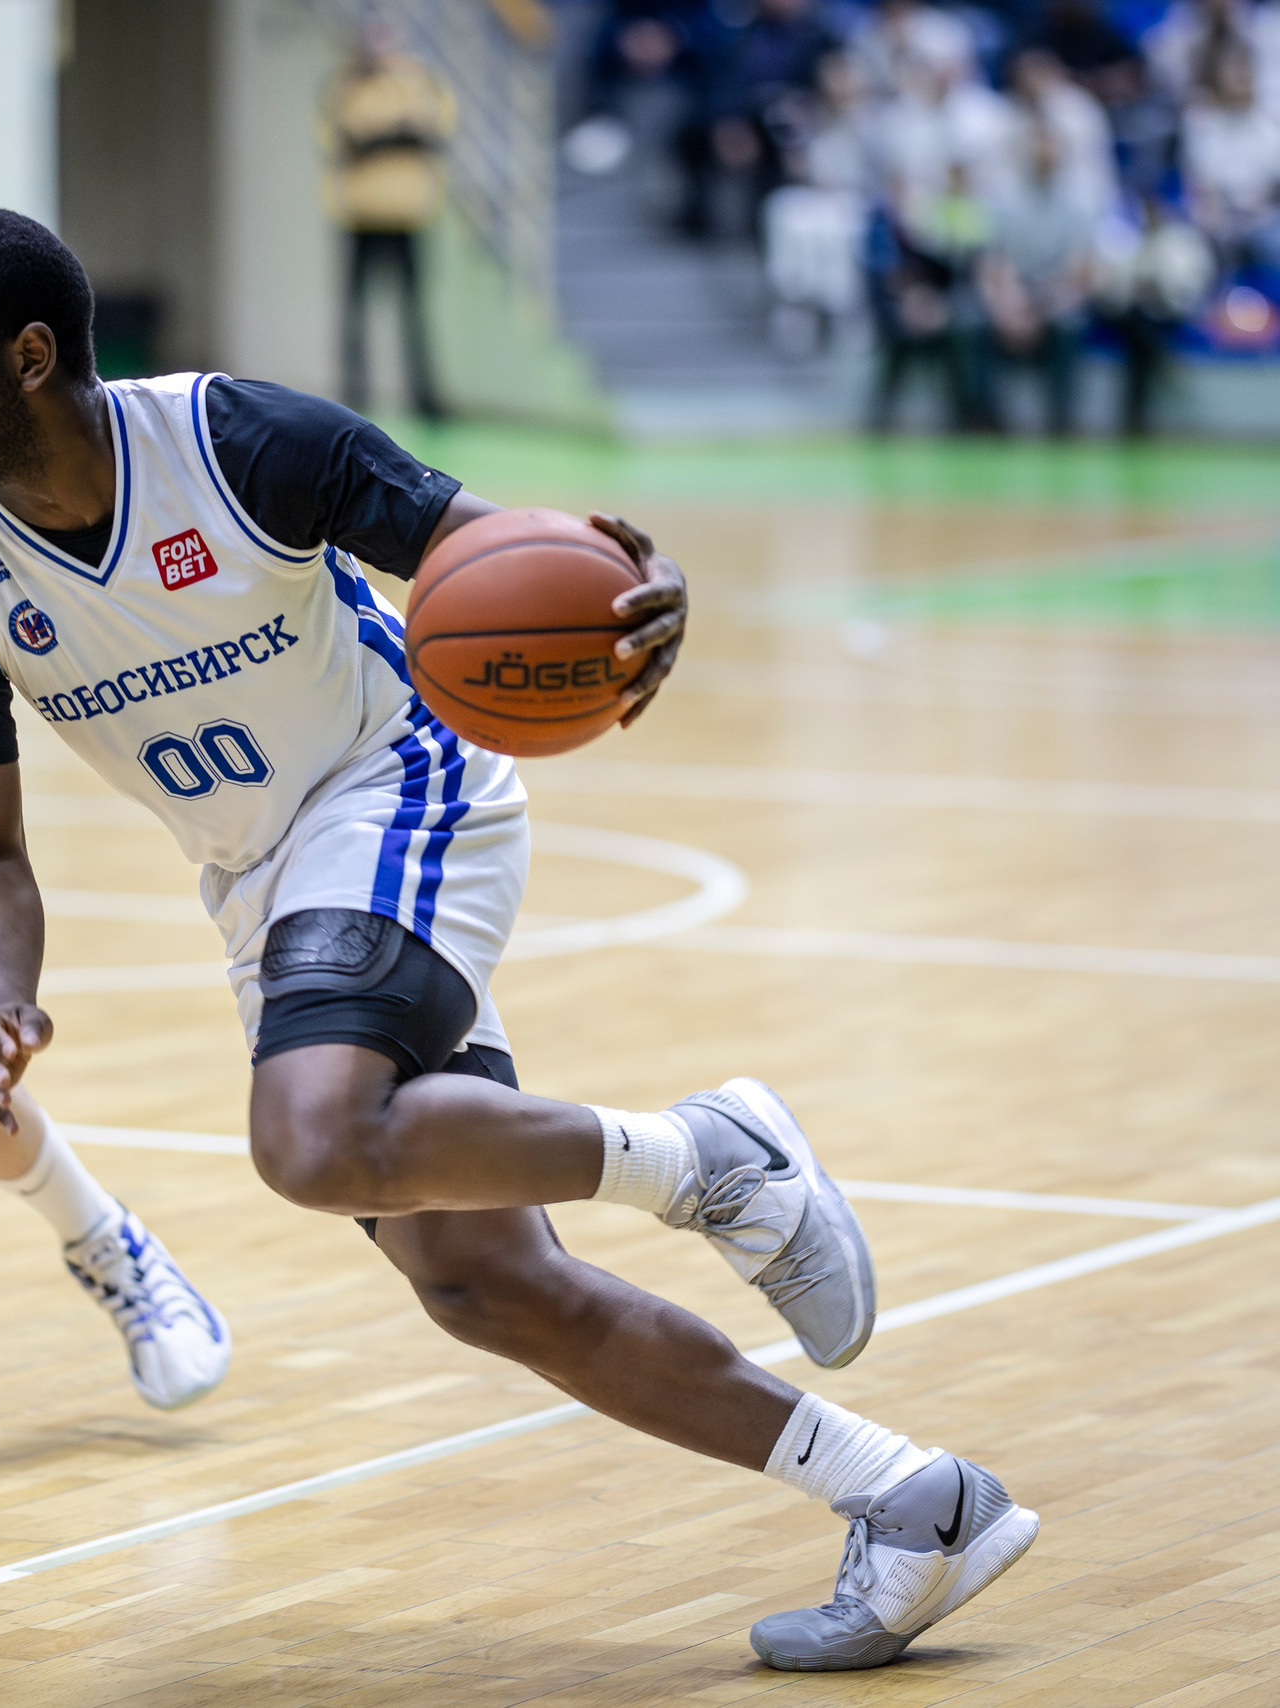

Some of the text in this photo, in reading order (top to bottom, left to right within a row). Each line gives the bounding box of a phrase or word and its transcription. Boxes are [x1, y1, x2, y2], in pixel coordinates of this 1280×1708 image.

[159, 533, 202, 567] FON
[166, 551, 207, 585] BET
[34, 614, 299, 722] НОВОСИБИРСК
[463, 652, 626, 691] JÖGEL
[137, 718, 275, 801] 00
